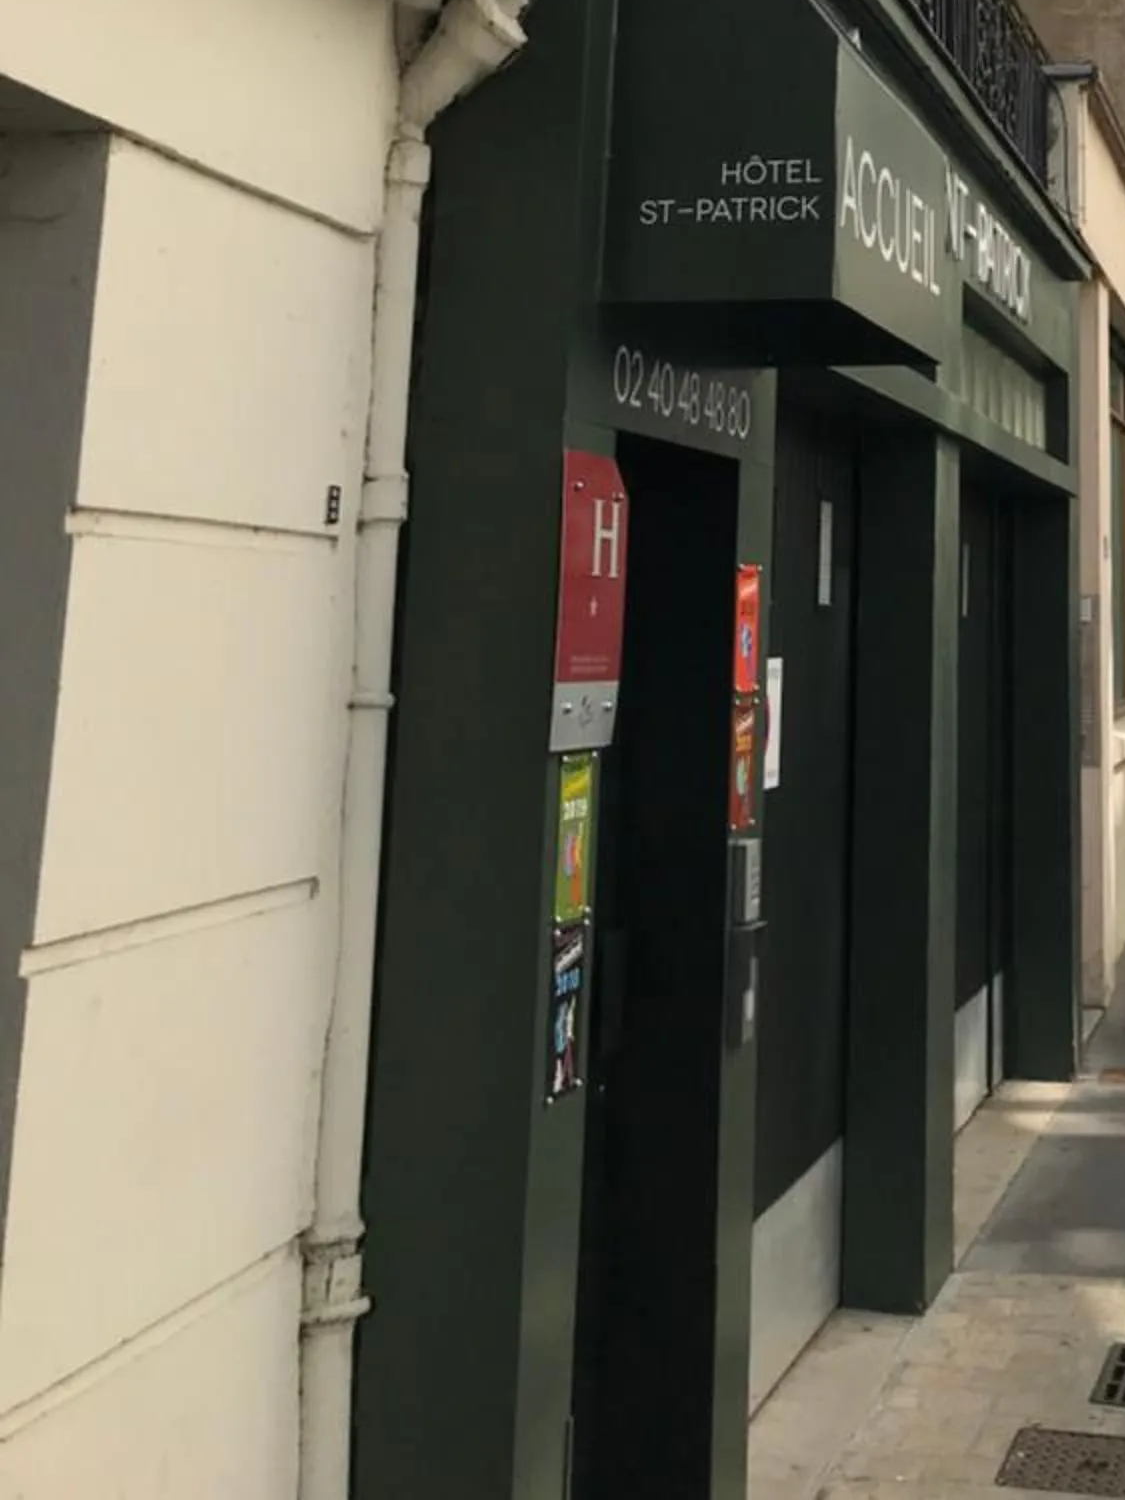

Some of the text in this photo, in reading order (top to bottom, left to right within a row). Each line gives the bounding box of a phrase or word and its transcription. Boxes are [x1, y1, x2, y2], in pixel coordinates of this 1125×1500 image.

[720, 154, 824, 186] HÔTEL
[639, 195, 821, 226] ST-PATRICK
[840, 135, 942, 297] ACCUEIL
[613, 344, 750, 440] 02 40 48 48 80
[591, 499, 622, 579] H
